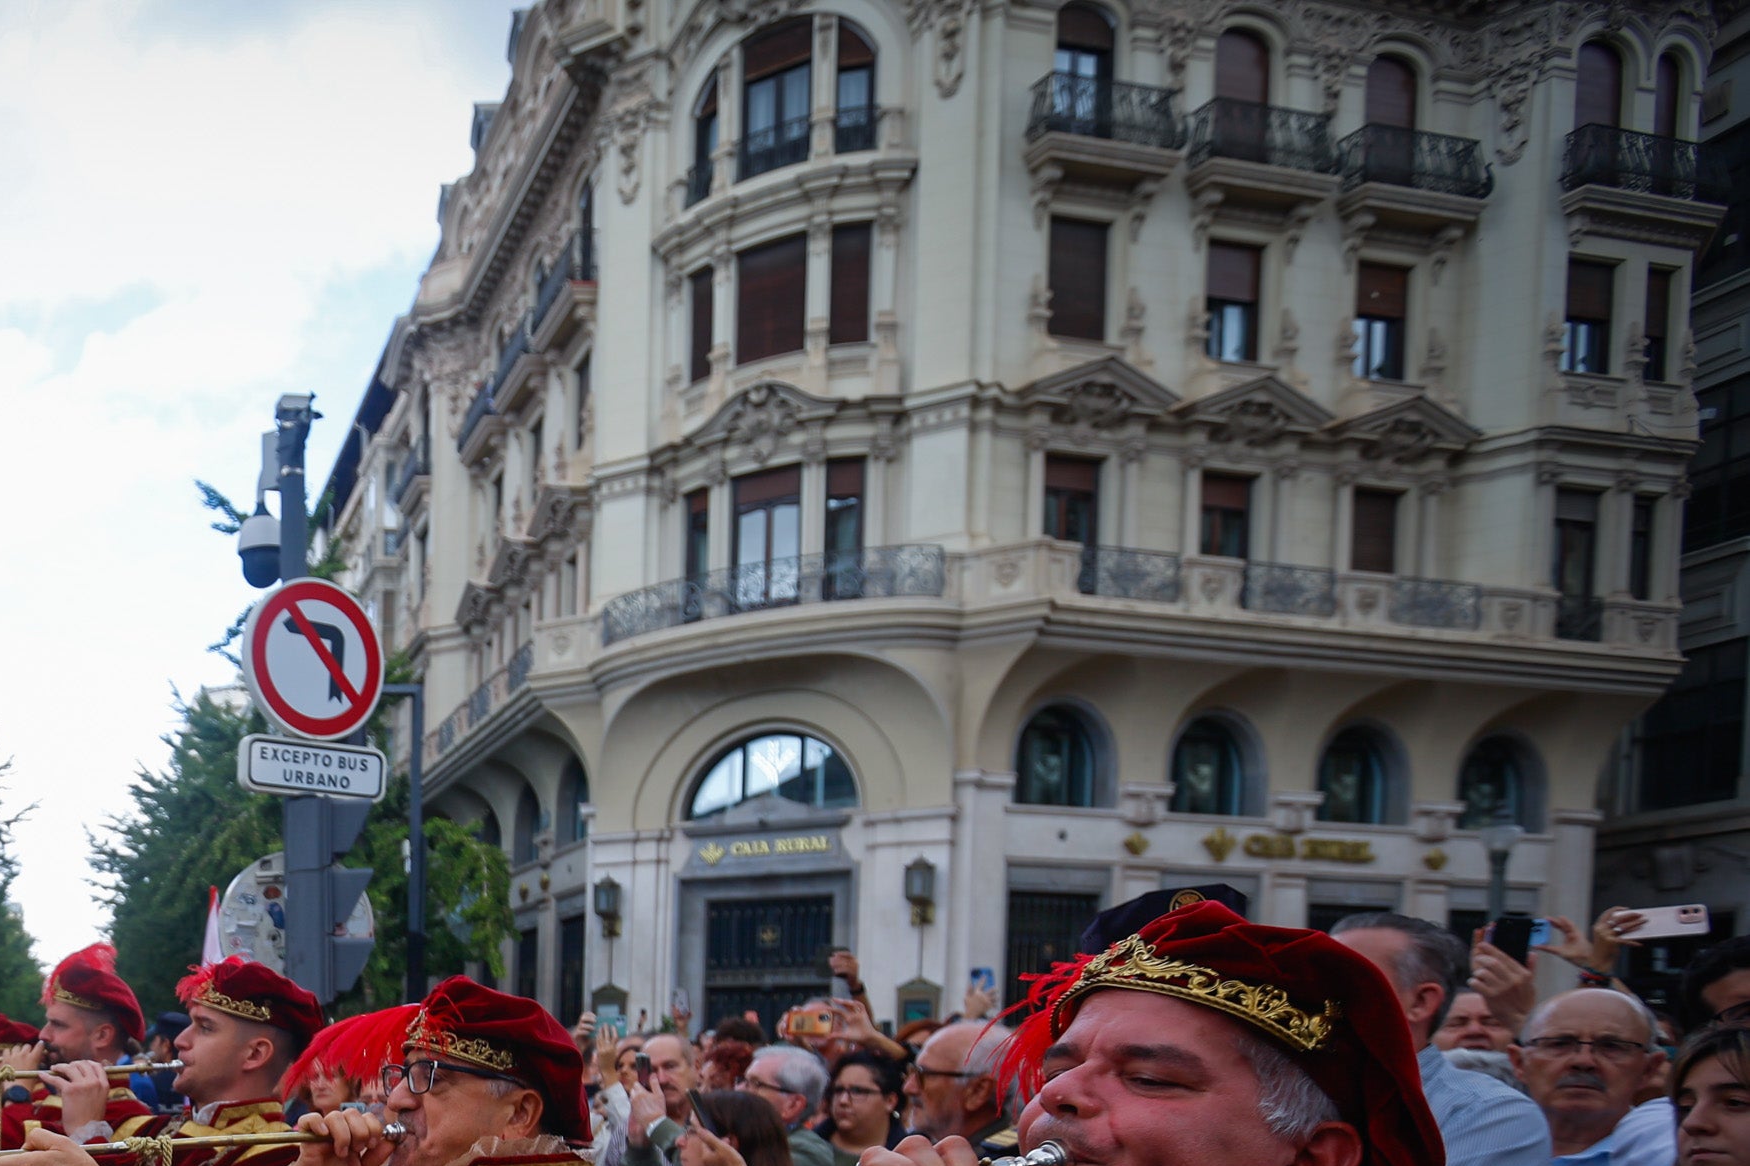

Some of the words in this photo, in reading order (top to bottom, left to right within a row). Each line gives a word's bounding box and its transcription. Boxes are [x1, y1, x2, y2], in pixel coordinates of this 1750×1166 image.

[260, 746, 332, 767] EXCEPTO
[338, 756, 368, 772] BUS
[283, 769, 350, 789] URBANO
